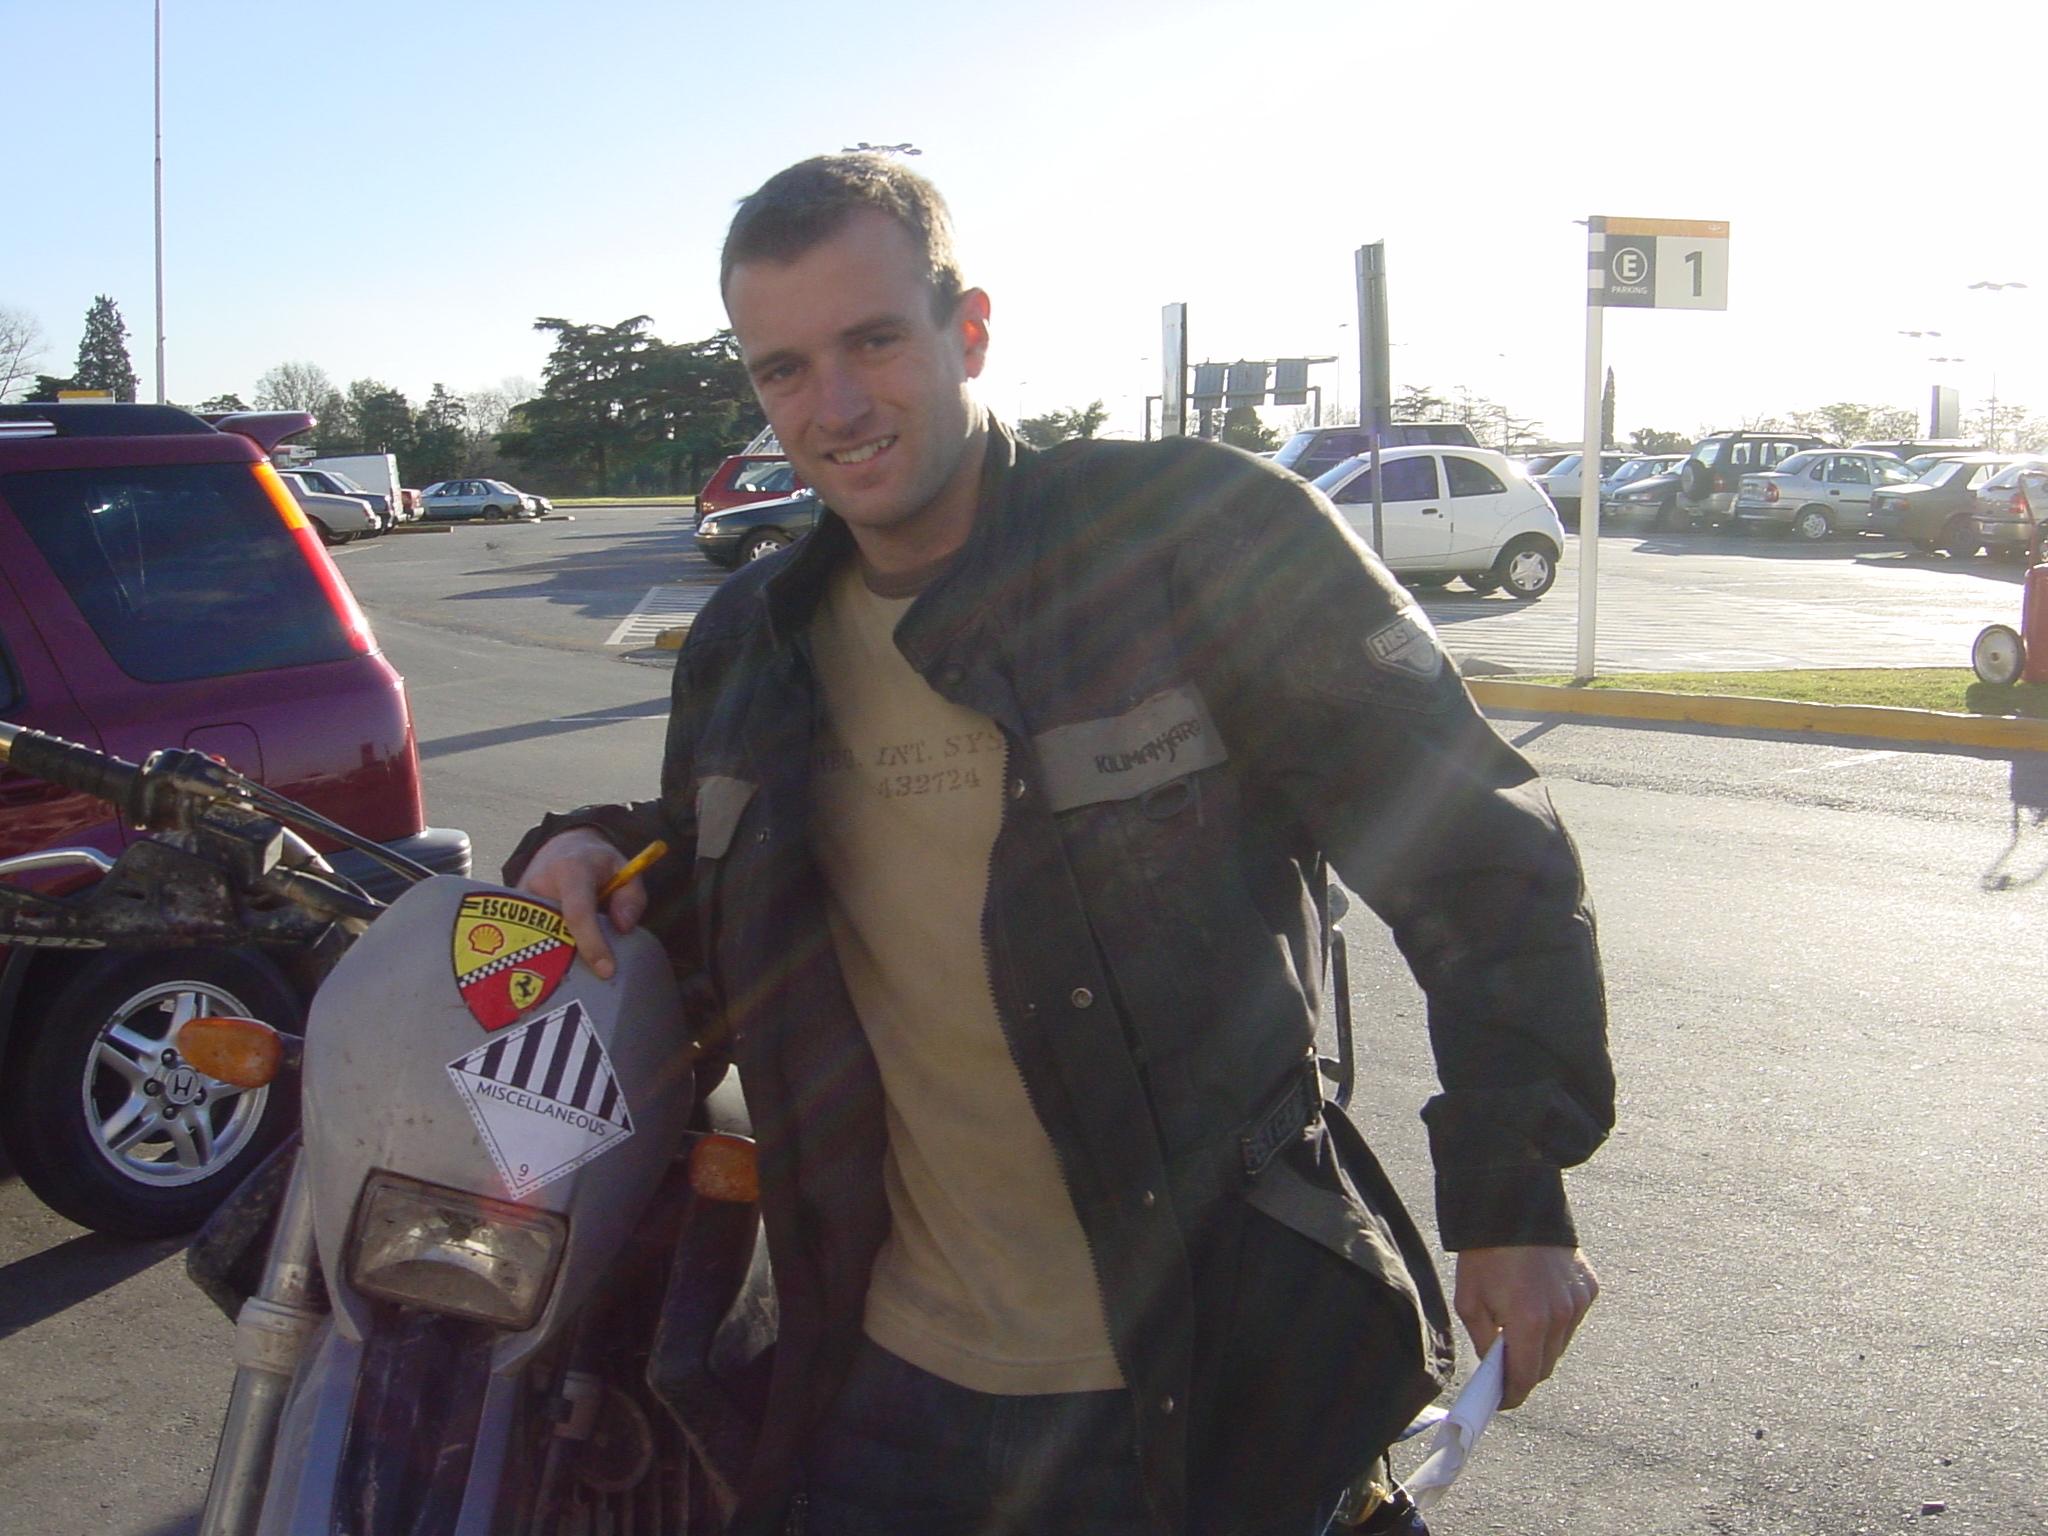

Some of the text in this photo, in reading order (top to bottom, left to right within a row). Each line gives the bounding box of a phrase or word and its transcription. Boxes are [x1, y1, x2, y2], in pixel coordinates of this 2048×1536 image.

[1622, 254, 1638, 277] E
[1684, 250, 1703, 297] 1
[1611, 285, 1648, 295] PARKING
[481, 898, 563, 936] ESCUDERIA
[475, 1080, 607, 1137] MISCELLANEOUS
[518, 1163, 529, 1178] 9
